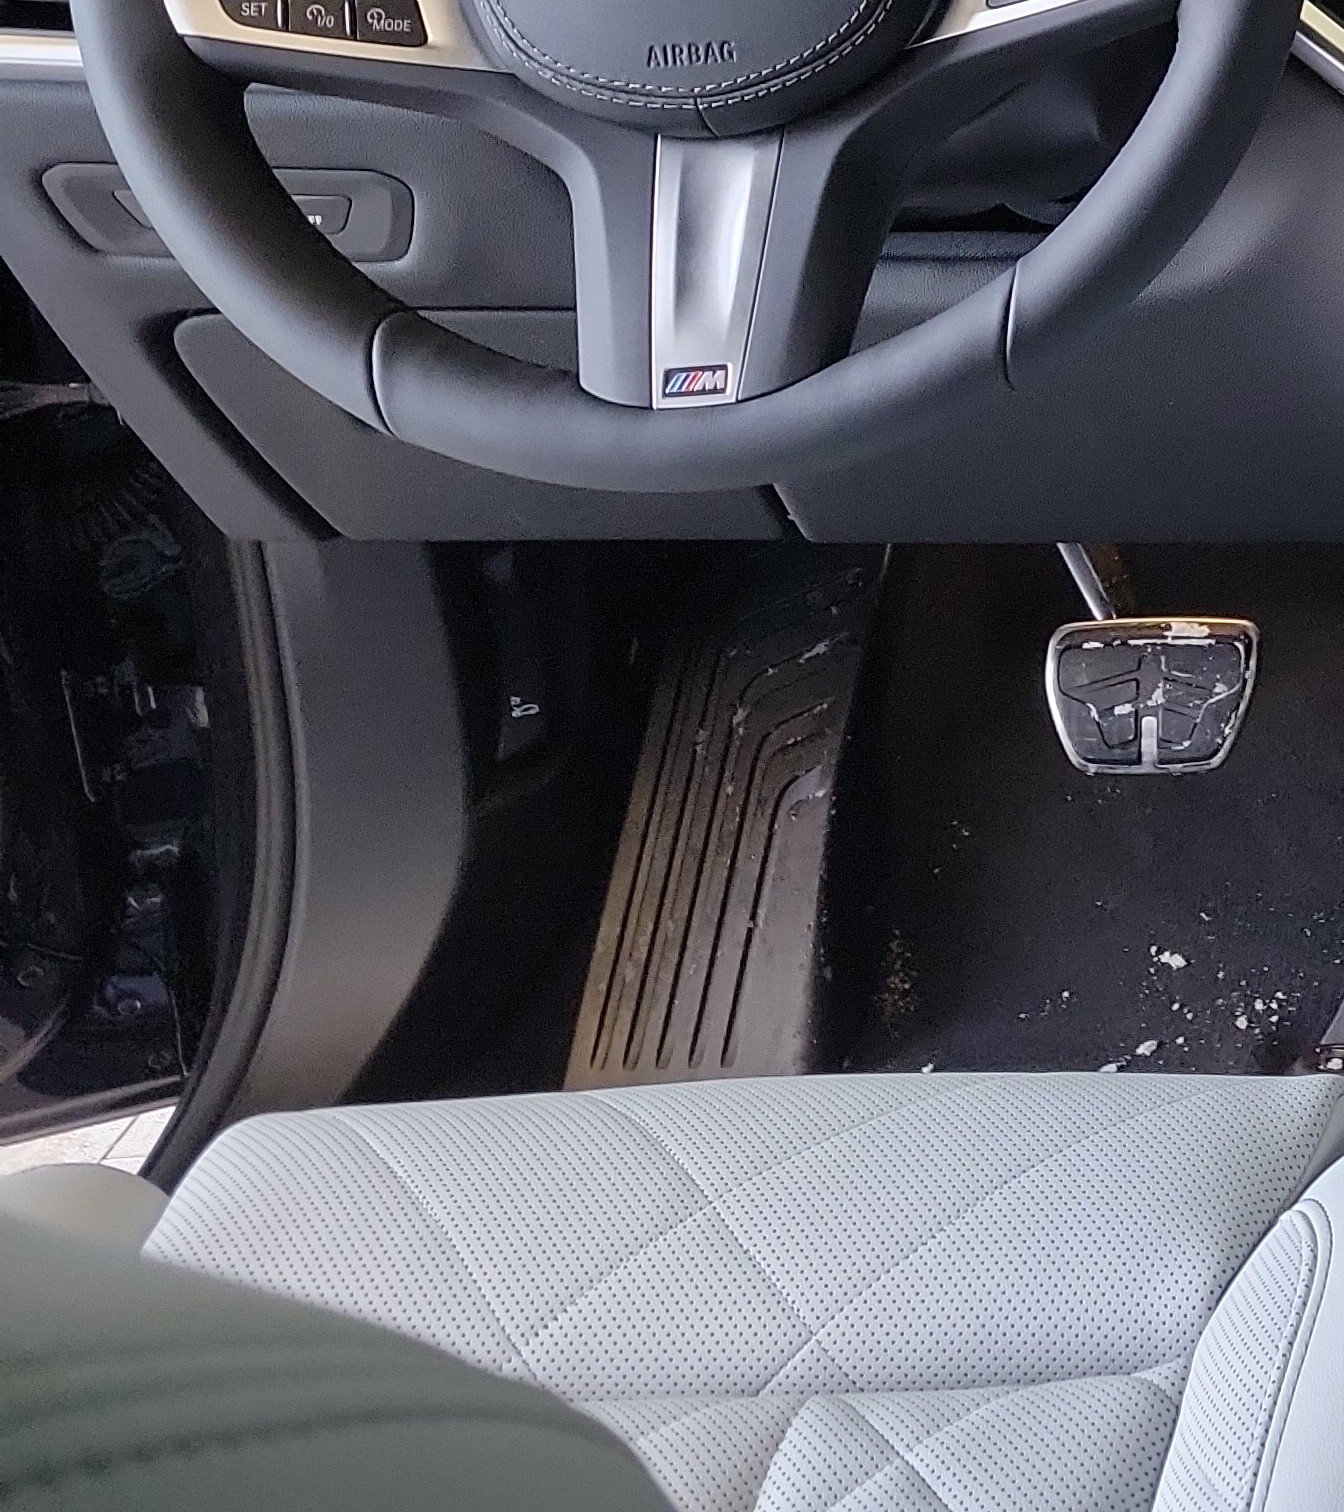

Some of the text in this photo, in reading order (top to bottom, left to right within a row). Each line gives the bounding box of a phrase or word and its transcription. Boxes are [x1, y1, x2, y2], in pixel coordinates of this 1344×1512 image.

[240, 1, 268, 17] SET
[372, 18, 412, 32] MODE
[646, 40, 737, 68] AIRBAG
